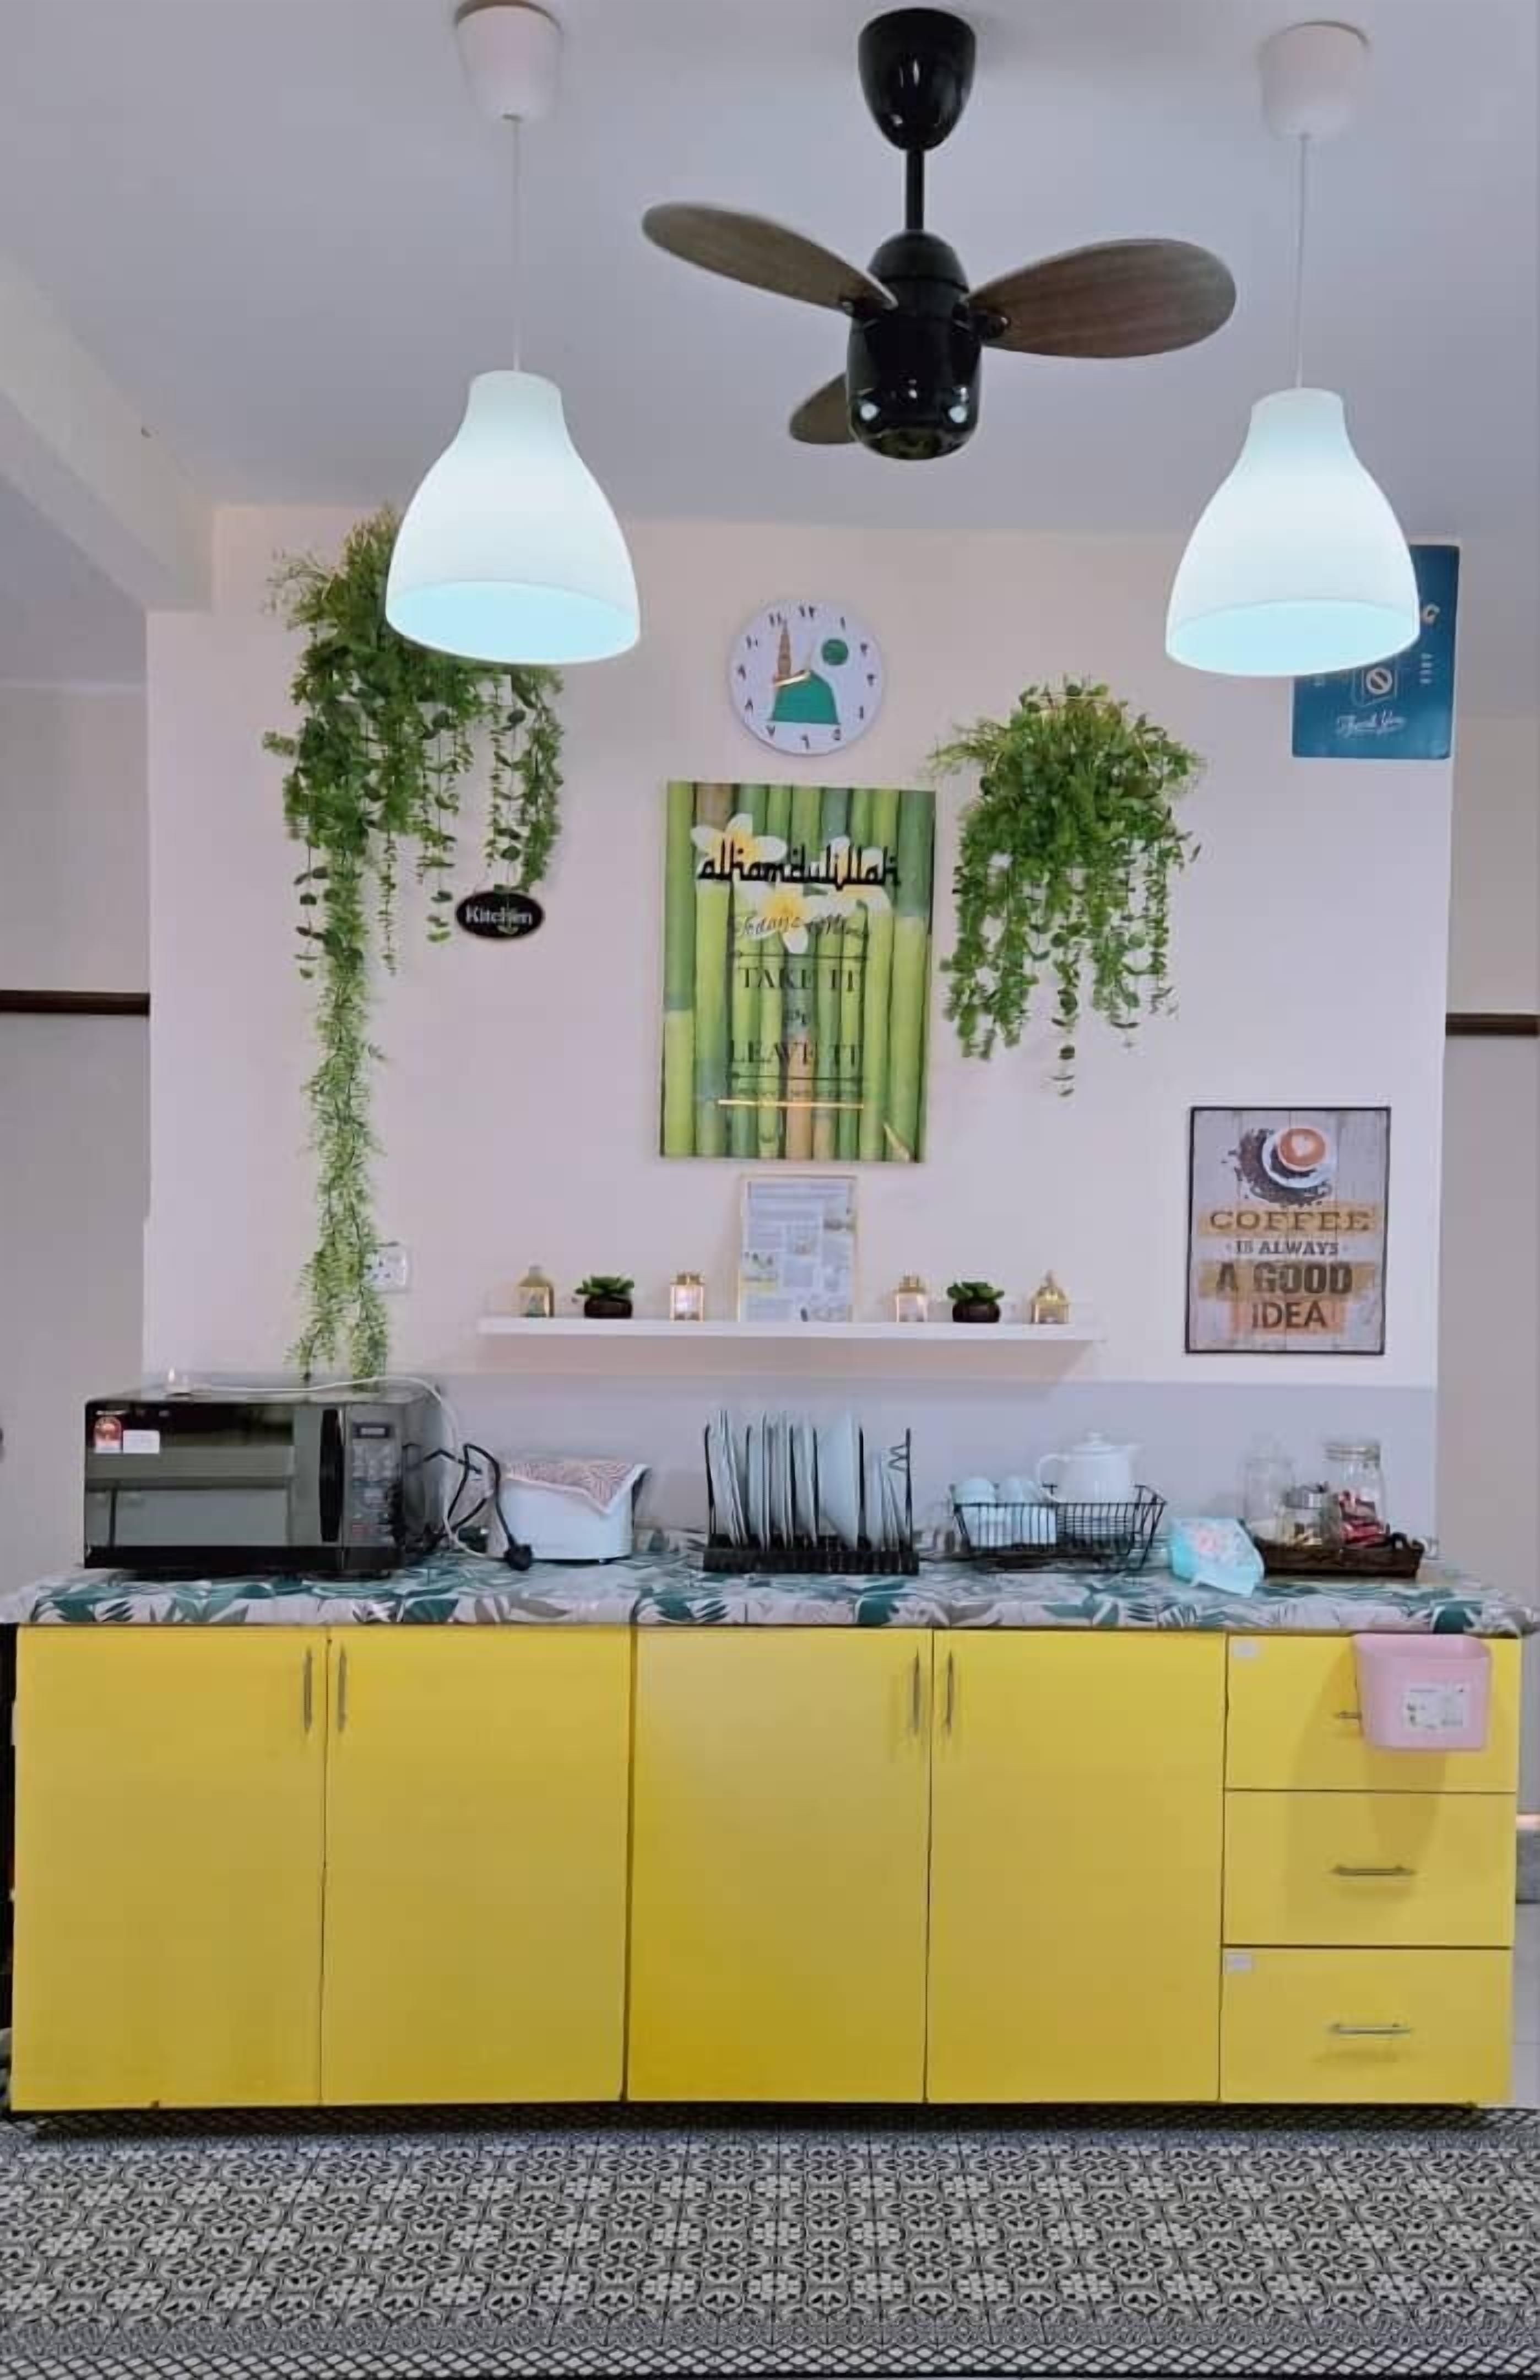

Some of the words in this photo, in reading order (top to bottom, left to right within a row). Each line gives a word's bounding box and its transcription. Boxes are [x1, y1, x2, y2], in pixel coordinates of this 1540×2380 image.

[738, 967, 811, 989] TAKE
[829, 968, 860, 992] IT
[728, 1039, 817, 1066] LEAVE
[1210, 1210, 1370, 1231] COFFEE
[1236, 1240, 1254, 1254] IS
[1259, 1241, 1340, 1256] ALWAYS
[1216, 1262, 1239, 1292] A
[1254, 1262, 1353, 1294] GOOD
[1252, 1300, 1327, 1329] IDEA
